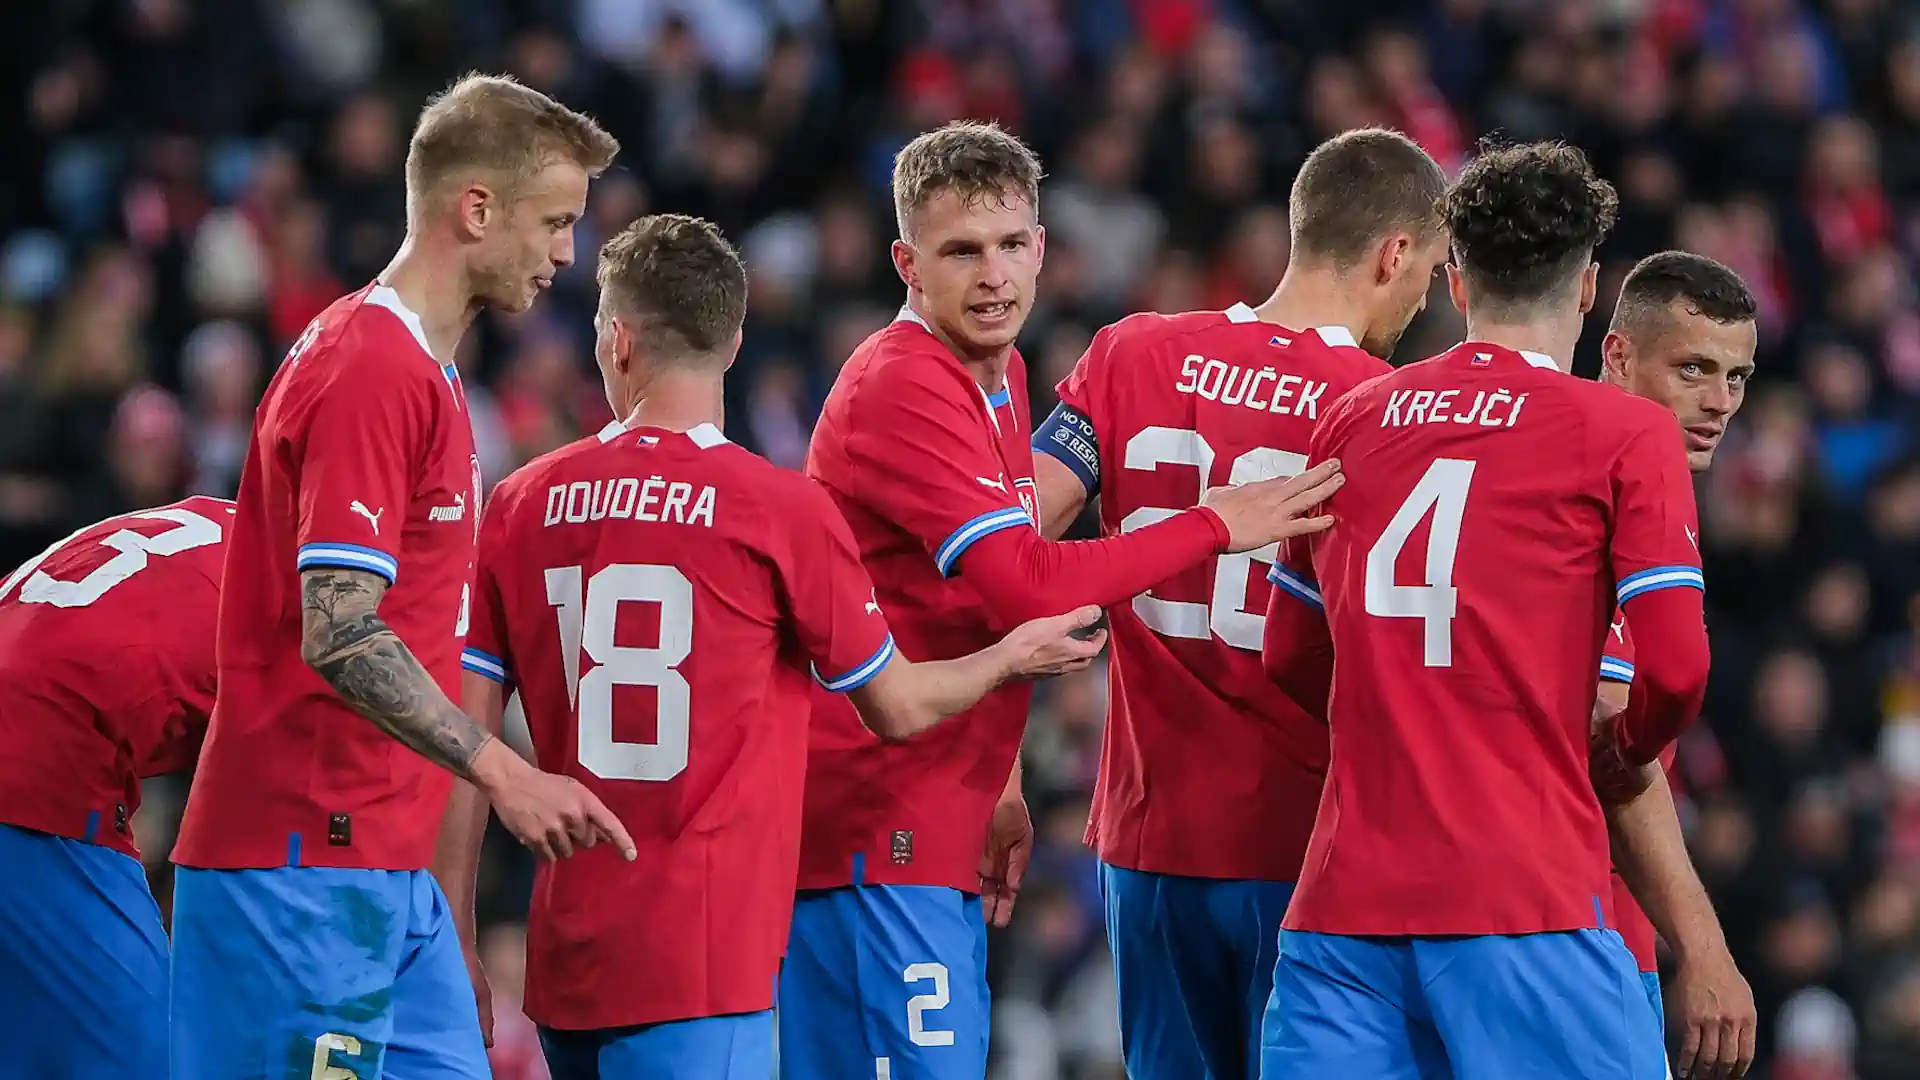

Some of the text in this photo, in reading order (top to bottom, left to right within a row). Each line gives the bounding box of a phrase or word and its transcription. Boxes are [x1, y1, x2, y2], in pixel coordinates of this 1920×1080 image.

[1176, 354, 1328, 419] SOUČEK
[1380, 387, 1530, 427] KREJČÍ
[1060, 411, 1093, 436] NO TO
[544, 475, 717, 527] DOUDĚRA
[1365, 457, 1476, 667] 4
[544, 563, 693, 781] 18
[904, 962, 954, 1046] 2
